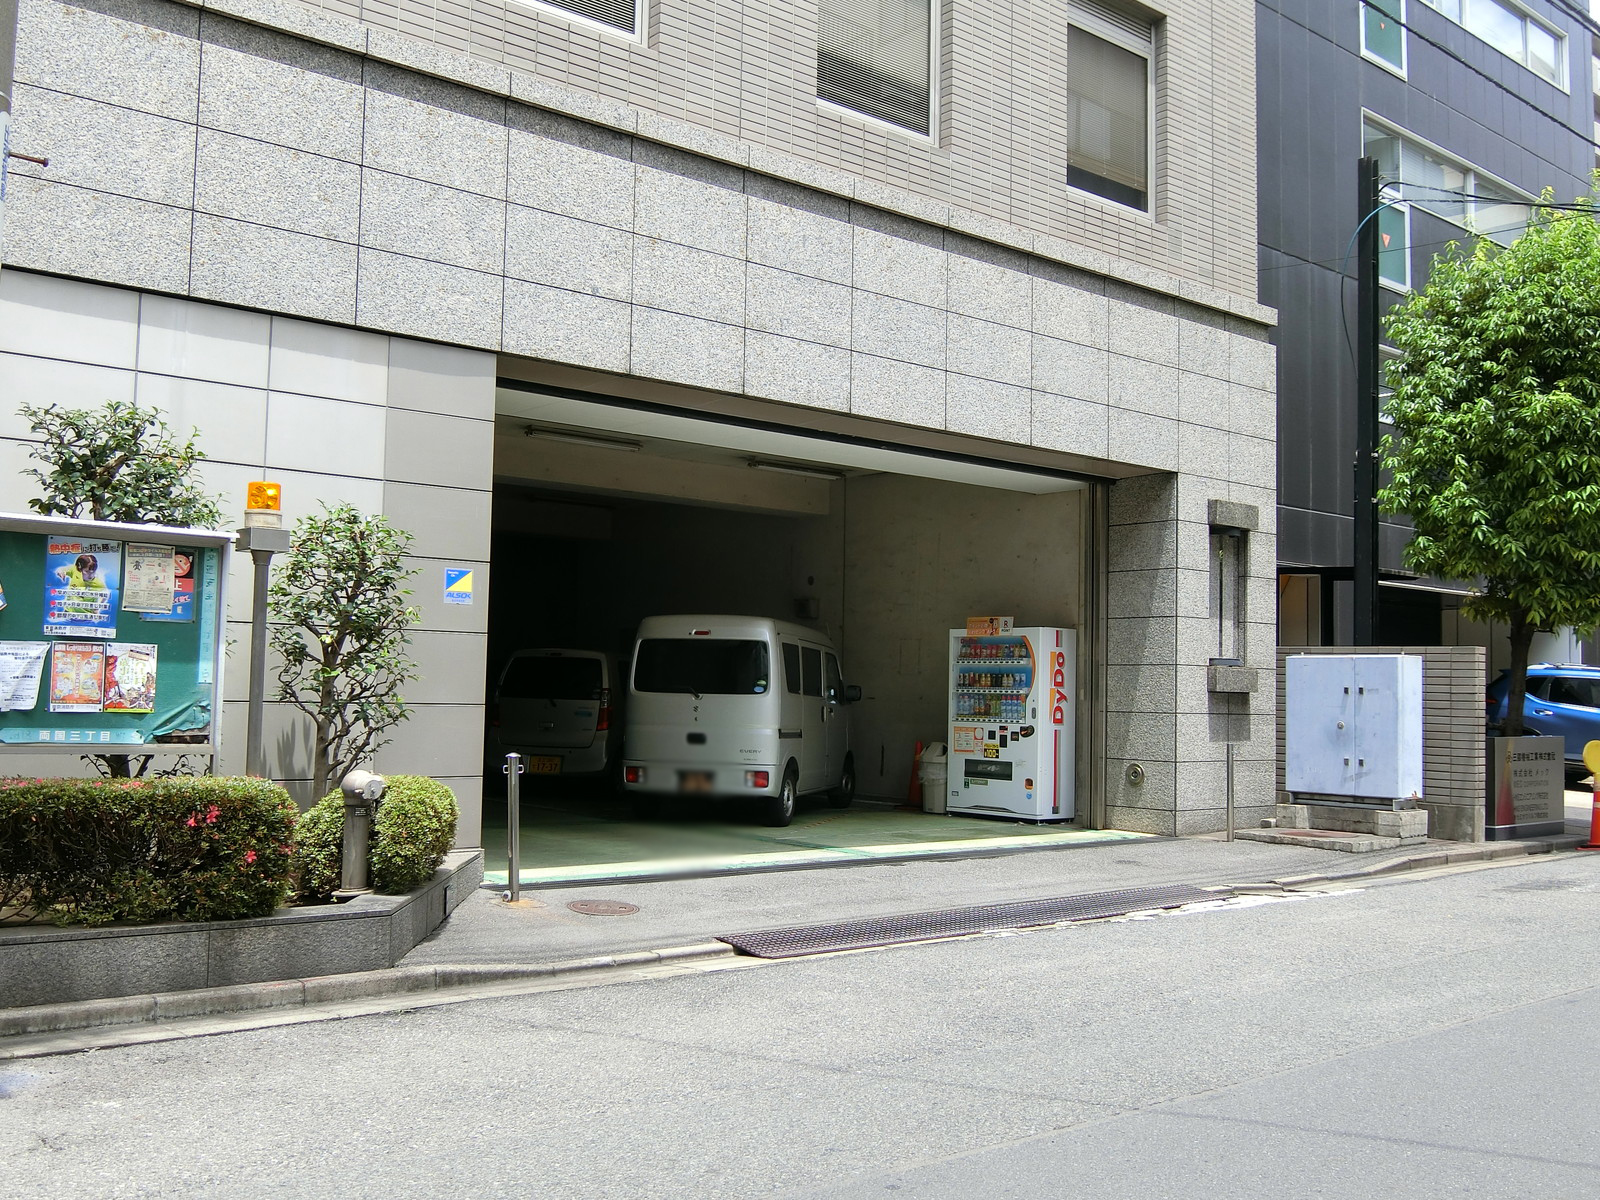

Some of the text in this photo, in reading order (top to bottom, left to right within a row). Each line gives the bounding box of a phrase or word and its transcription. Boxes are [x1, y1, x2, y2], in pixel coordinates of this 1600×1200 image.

[39, 730, 110, 742] 両国三丁目
